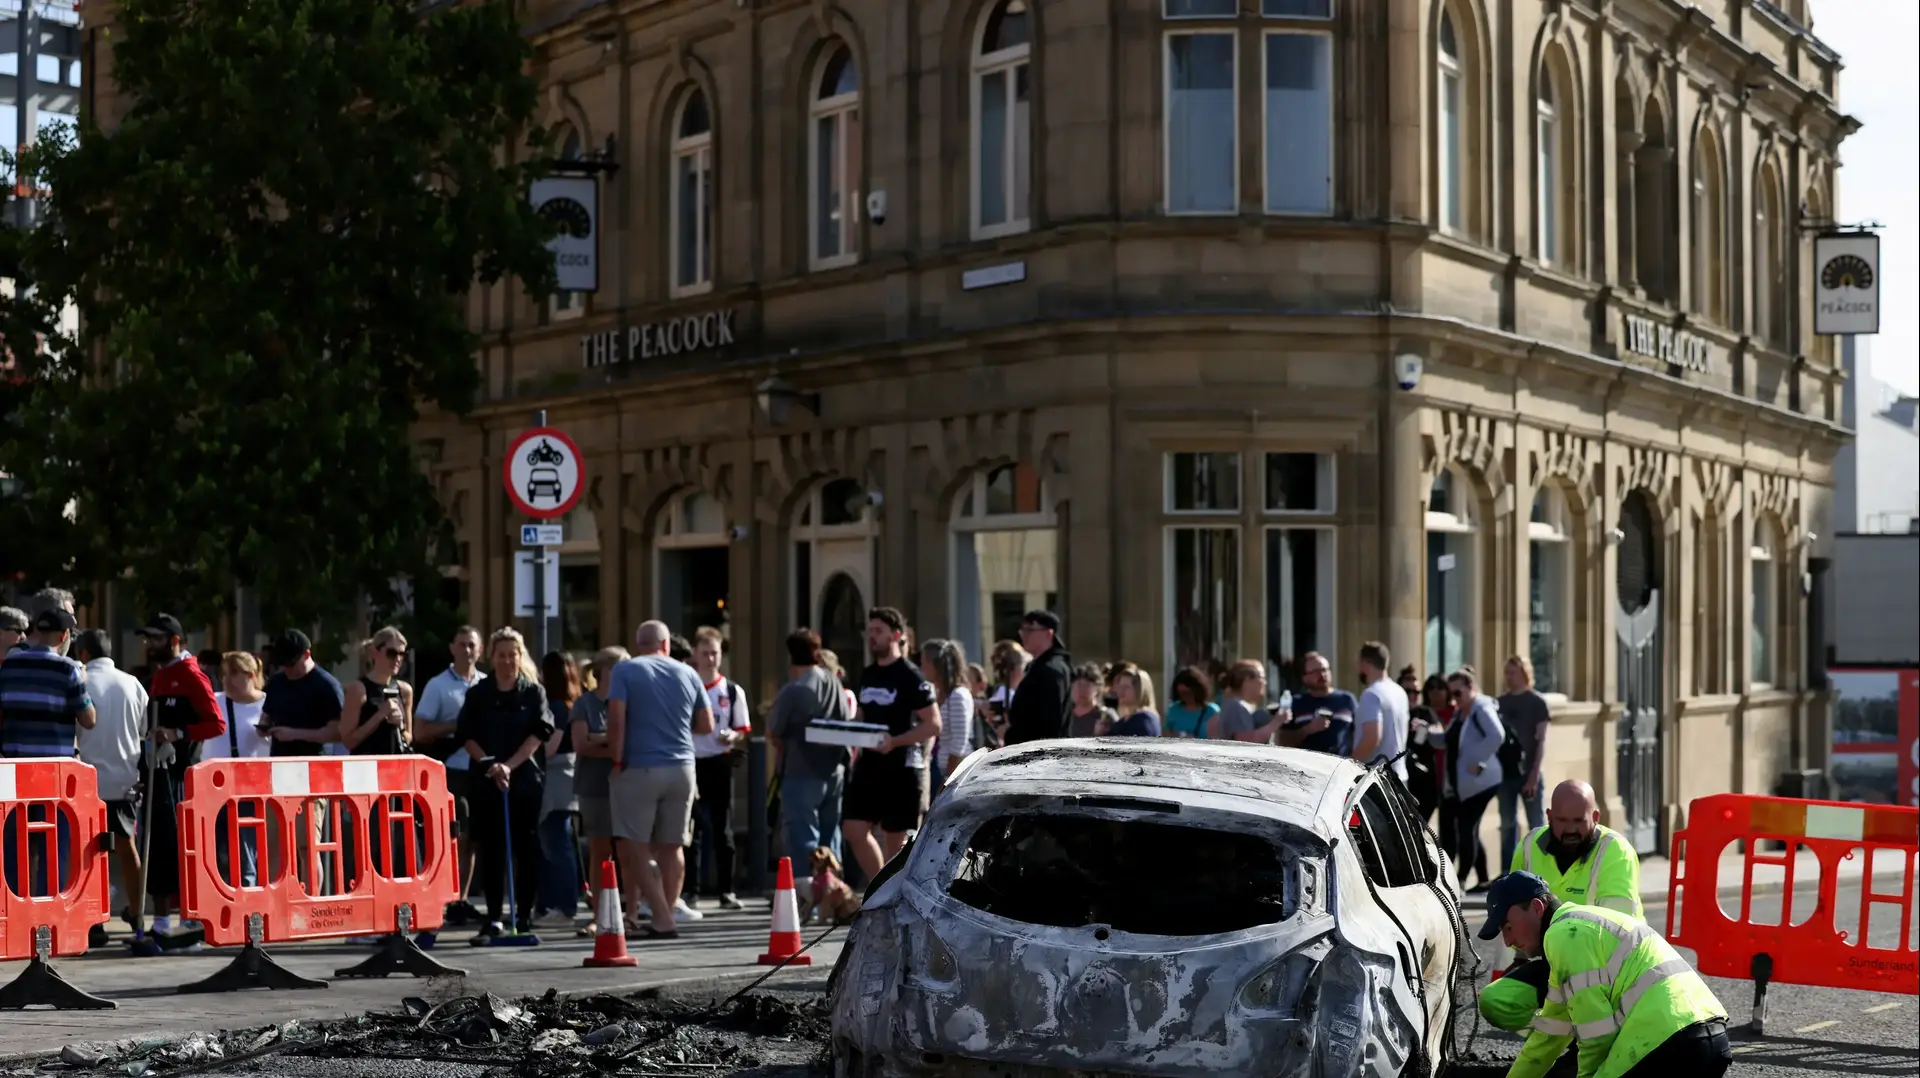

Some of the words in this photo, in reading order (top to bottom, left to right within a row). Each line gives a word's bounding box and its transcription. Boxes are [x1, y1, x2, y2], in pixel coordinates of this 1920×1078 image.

[1820, 301, 1873, 314] PEACOCK
[581, 330, 619, 367] THE
[628, 310, 735, 361] PEACOCK
[1626, 314, 1656, 356] THE
[1657, 324, 1714, 375] PEACOCK
[311, 904, 353, 918] Sunderland
[1848, 956, 1915, 973] Sunderland
